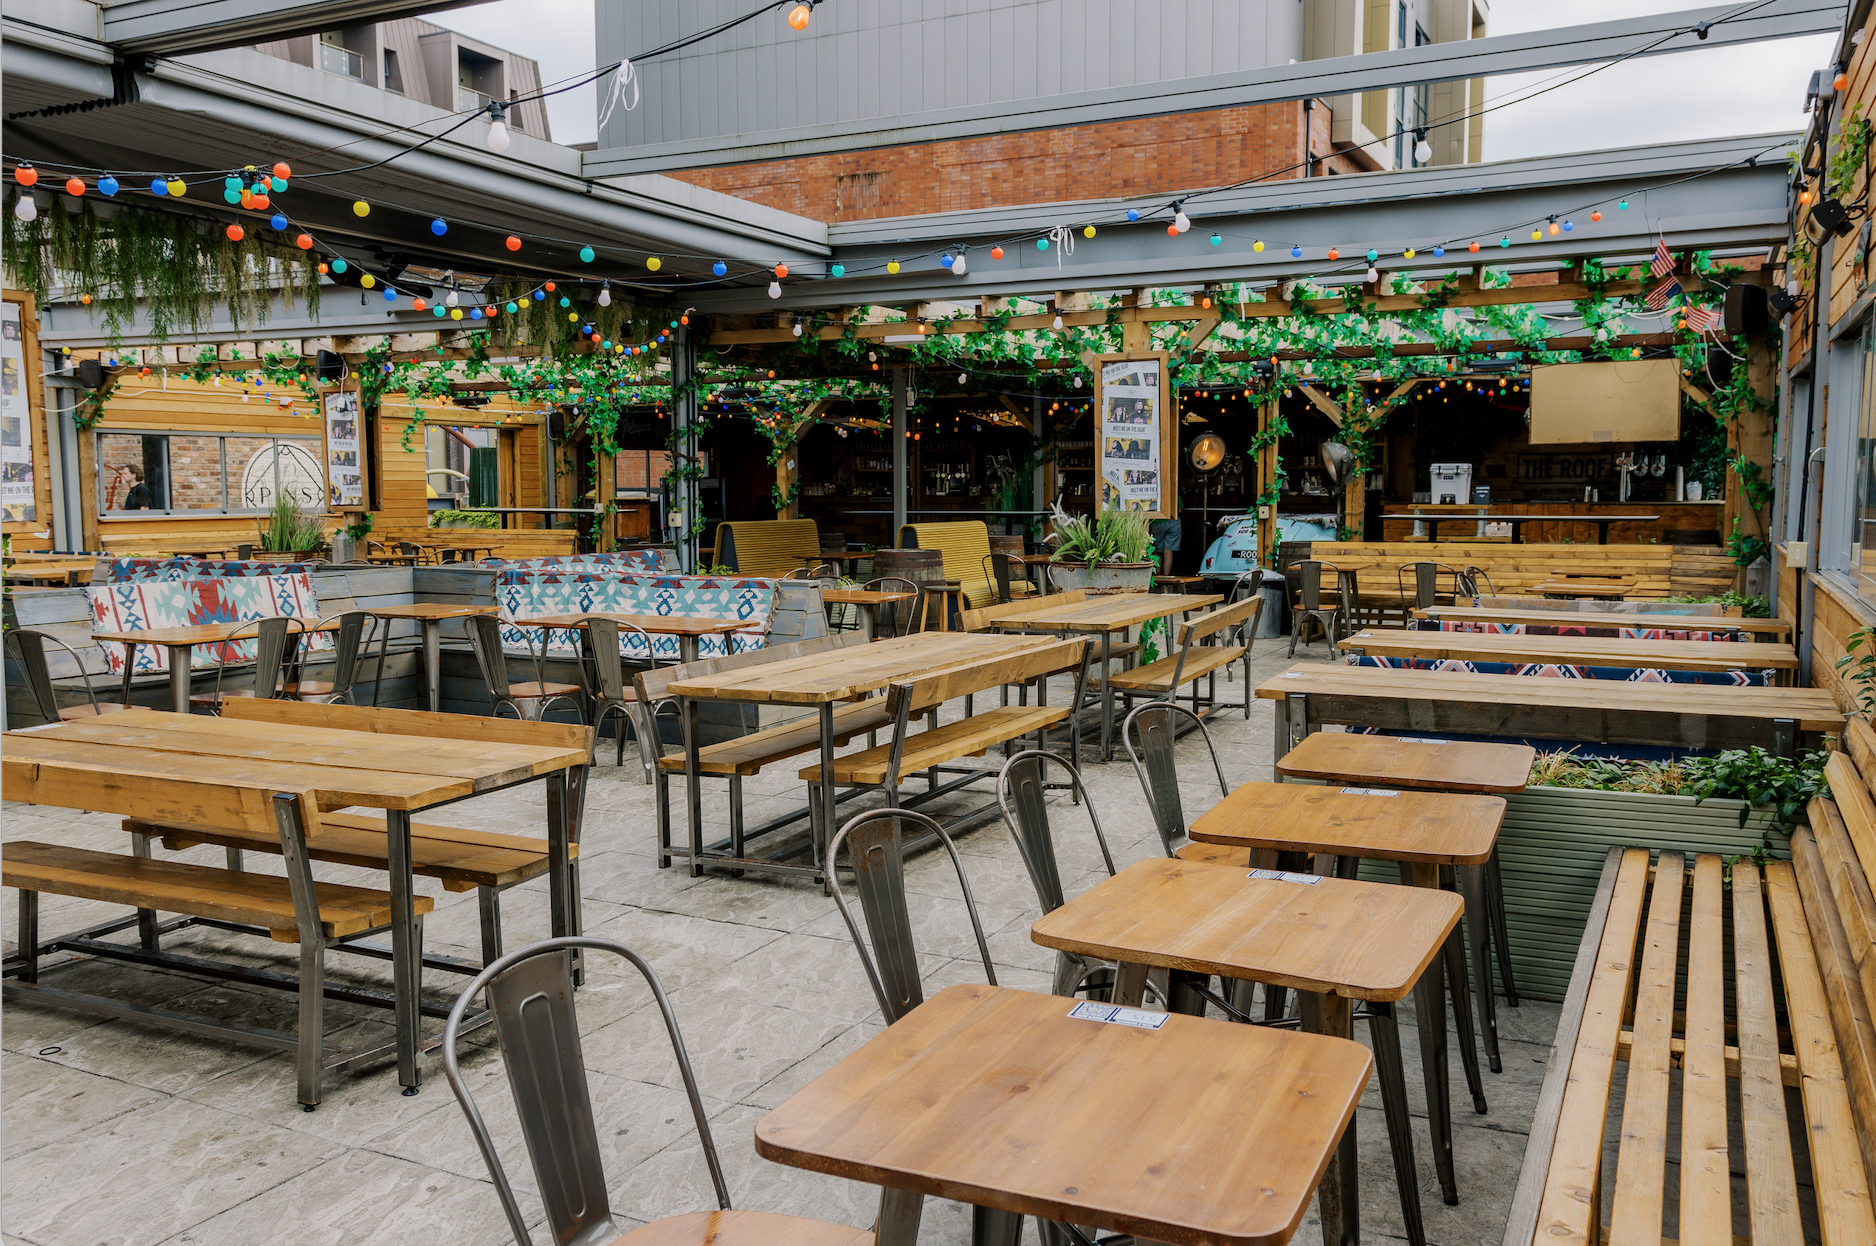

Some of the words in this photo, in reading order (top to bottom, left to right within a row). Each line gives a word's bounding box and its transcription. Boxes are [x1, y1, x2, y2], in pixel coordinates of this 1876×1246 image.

[1524, 458, 1554, 478] THE
[1560, 458, 1607, 478] ROOF
[260, 486, 312, 504] PNS
